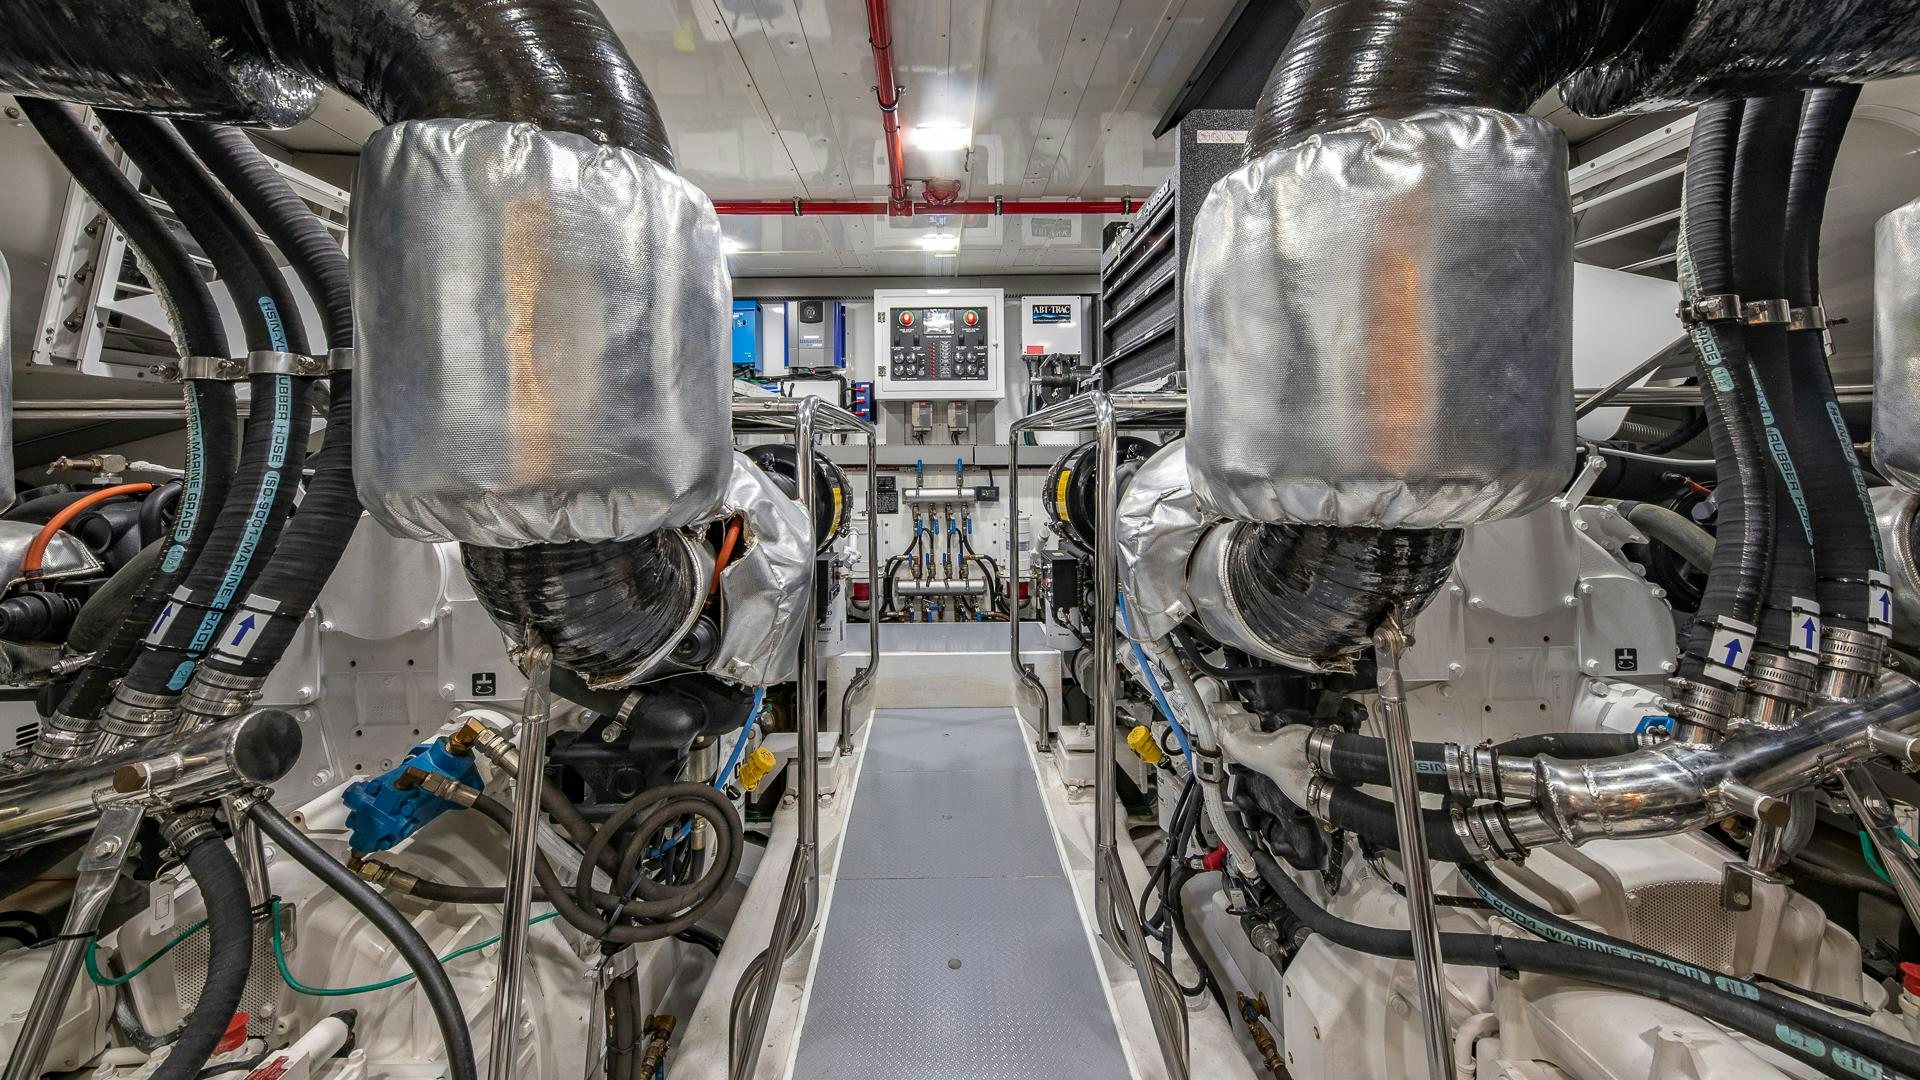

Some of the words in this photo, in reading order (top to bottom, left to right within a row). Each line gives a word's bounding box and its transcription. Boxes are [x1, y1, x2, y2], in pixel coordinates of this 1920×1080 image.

[270, 425, 286, 463] HOSE
[177, 492, 198, 538] GRADE
[193, 602, 225, 650] GRADE
